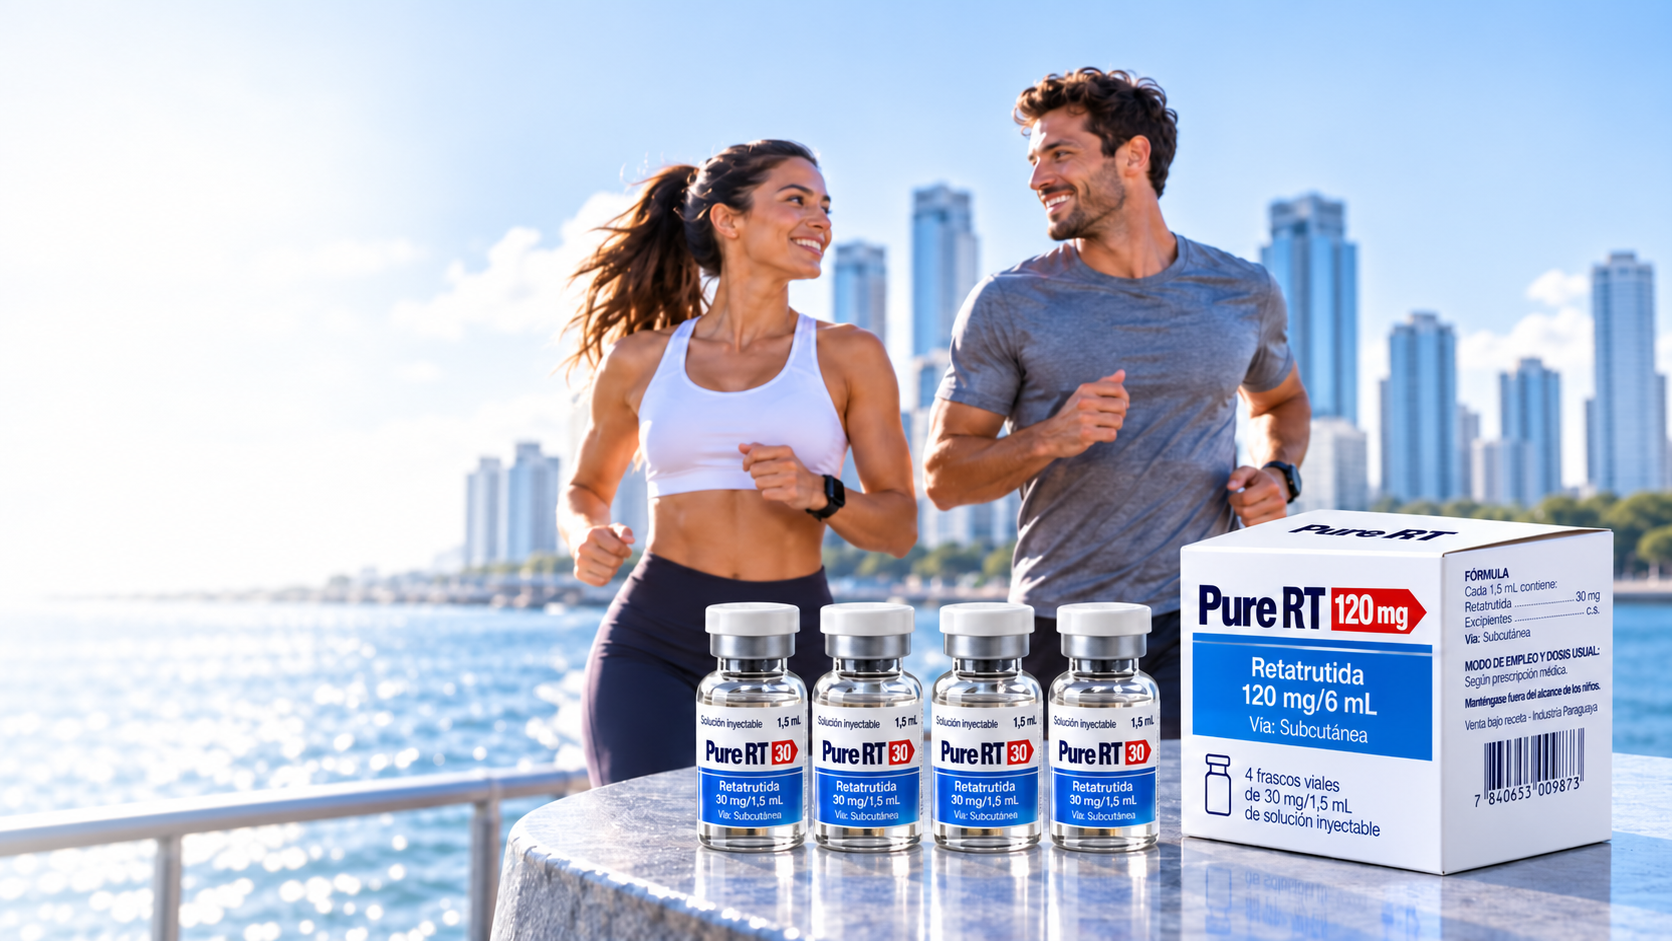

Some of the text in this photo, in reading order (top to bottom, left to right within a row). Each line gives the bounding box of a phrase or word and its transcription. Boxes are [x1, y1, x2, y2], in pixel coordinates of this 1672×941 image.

[1288, 524, 1458, 541] Pure RT
[1465, 568, 1509, 582] FÓRMULA
[1465, 580, 1557, 597] Cada 1,5 mL contiene:
[1199, 584, 1409, 631] Pure RT 120 mg
[1465, 591, 1600, 613] Retatrutida 30 mg
[1465, 614, 1512, 628] Excipientes
[1483, 629, 1531, 643] Subcutánea
[1465, 646, 1600, 672] MODO DE EMPLEO Y DOSIS USUAL:
[1252, 656, 1364, 686] Retatrutida
[1465, 665, 1568, 690] Según prescripción médica.
[1242, 684, 1377, 715] 120 mg/6 mL
[1465, 681, 1601, 708] Manténgase fuera del alcance de los niños.
[701, 715, 801, 730] Solución inyectable 1,5 mL
[818, 715, 918, 730] Solución inyectable 1,5 mL
[936, 715, 1037, 730] Solución inyectable 1,5 mL
[1053, 715, 1154, 730] Solución inyectable 1,5 mL
[1465, 720, 1486, 730] Venta
[1488, 716, 1503, 729] bajo
[1505, 713, 1526, 725] receta
[1533, 708, 1562, 721] Industria
[1563, 703, 1598, 717] Paraguaya
[1249, 716, 1368, 744] Vía: Subcutánea
[706, 739, 792, 765] Pure RT 30
[822, 739, 909, 765] Pure RT 30
[941, 739, 1027, 765] Pure RT 30
[1059, 739, 1145, 765] Pure RT 30
[719, 781, 780, 793] Retatrutida
[836, 780, 897, 793] Retatrutida
[954, 780, 1016, 793] Retatrutida
[1073, 780, 1133, 793] Retatrutida
[1245, 767, 1340, 792] 4 frascos viales
[716, 794, 783, 809] 30 mg/1,5 mL
[833, 794, 900, 809] 30 mg/1,5 mL
[951, 794, 1019, 809] 30 mg/1,5 mL
[1069, 794, 1137, 809] 30 mg/1,5 mL
[1245, 787, 1352, 813] de 30 mg/1,5 mL
[1474, 777, 1580, 807] 7 840653 009873
[1245, 806, 1380, 837] de solución inyectable
